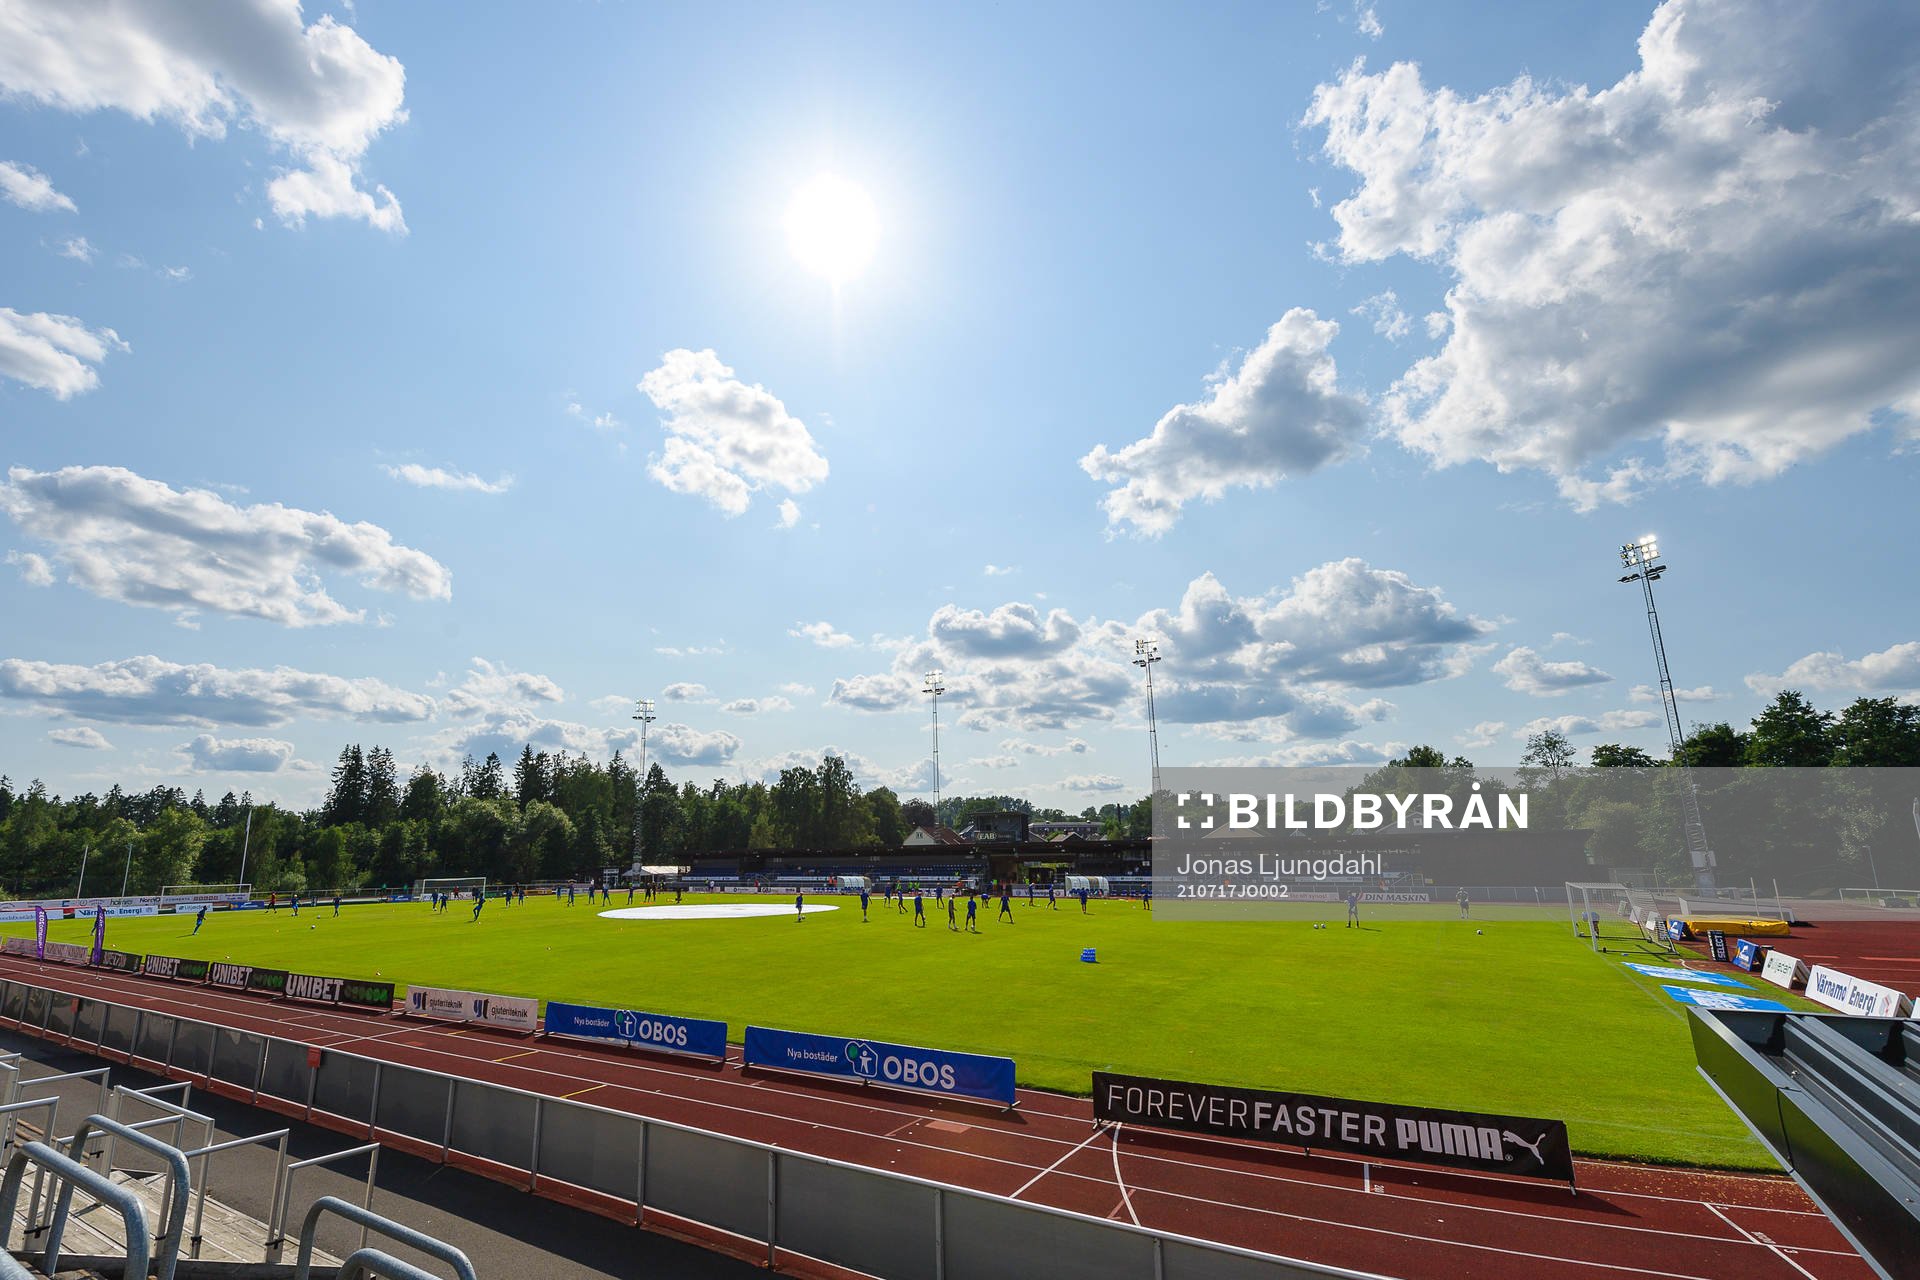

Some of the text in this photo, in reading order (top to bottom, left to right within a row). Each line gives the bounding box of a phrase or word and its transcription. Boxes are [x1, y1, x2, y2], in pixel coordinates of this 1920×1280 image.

[1365, 893, 1427, 902] DIN MASKIN
[1714, 935, 1726, 959] SELECT
[147, 955, 180, 976] UNIBET
[212, 963, 253, 988] UNIBET
[285, 974, 344, 1001] UNIBET
[1816, 972, 1878, 1015] Värnamo Energi
[573, 1016, 610, 1028] Nya bostäder
[638, 1019, 688, 1046] OBOS
[786, 1047, 839, 1063] Nya bostäder
[883, 1055, 956, 1090] OBOS
[1396, 1118, 1504, 1160] PUMA
